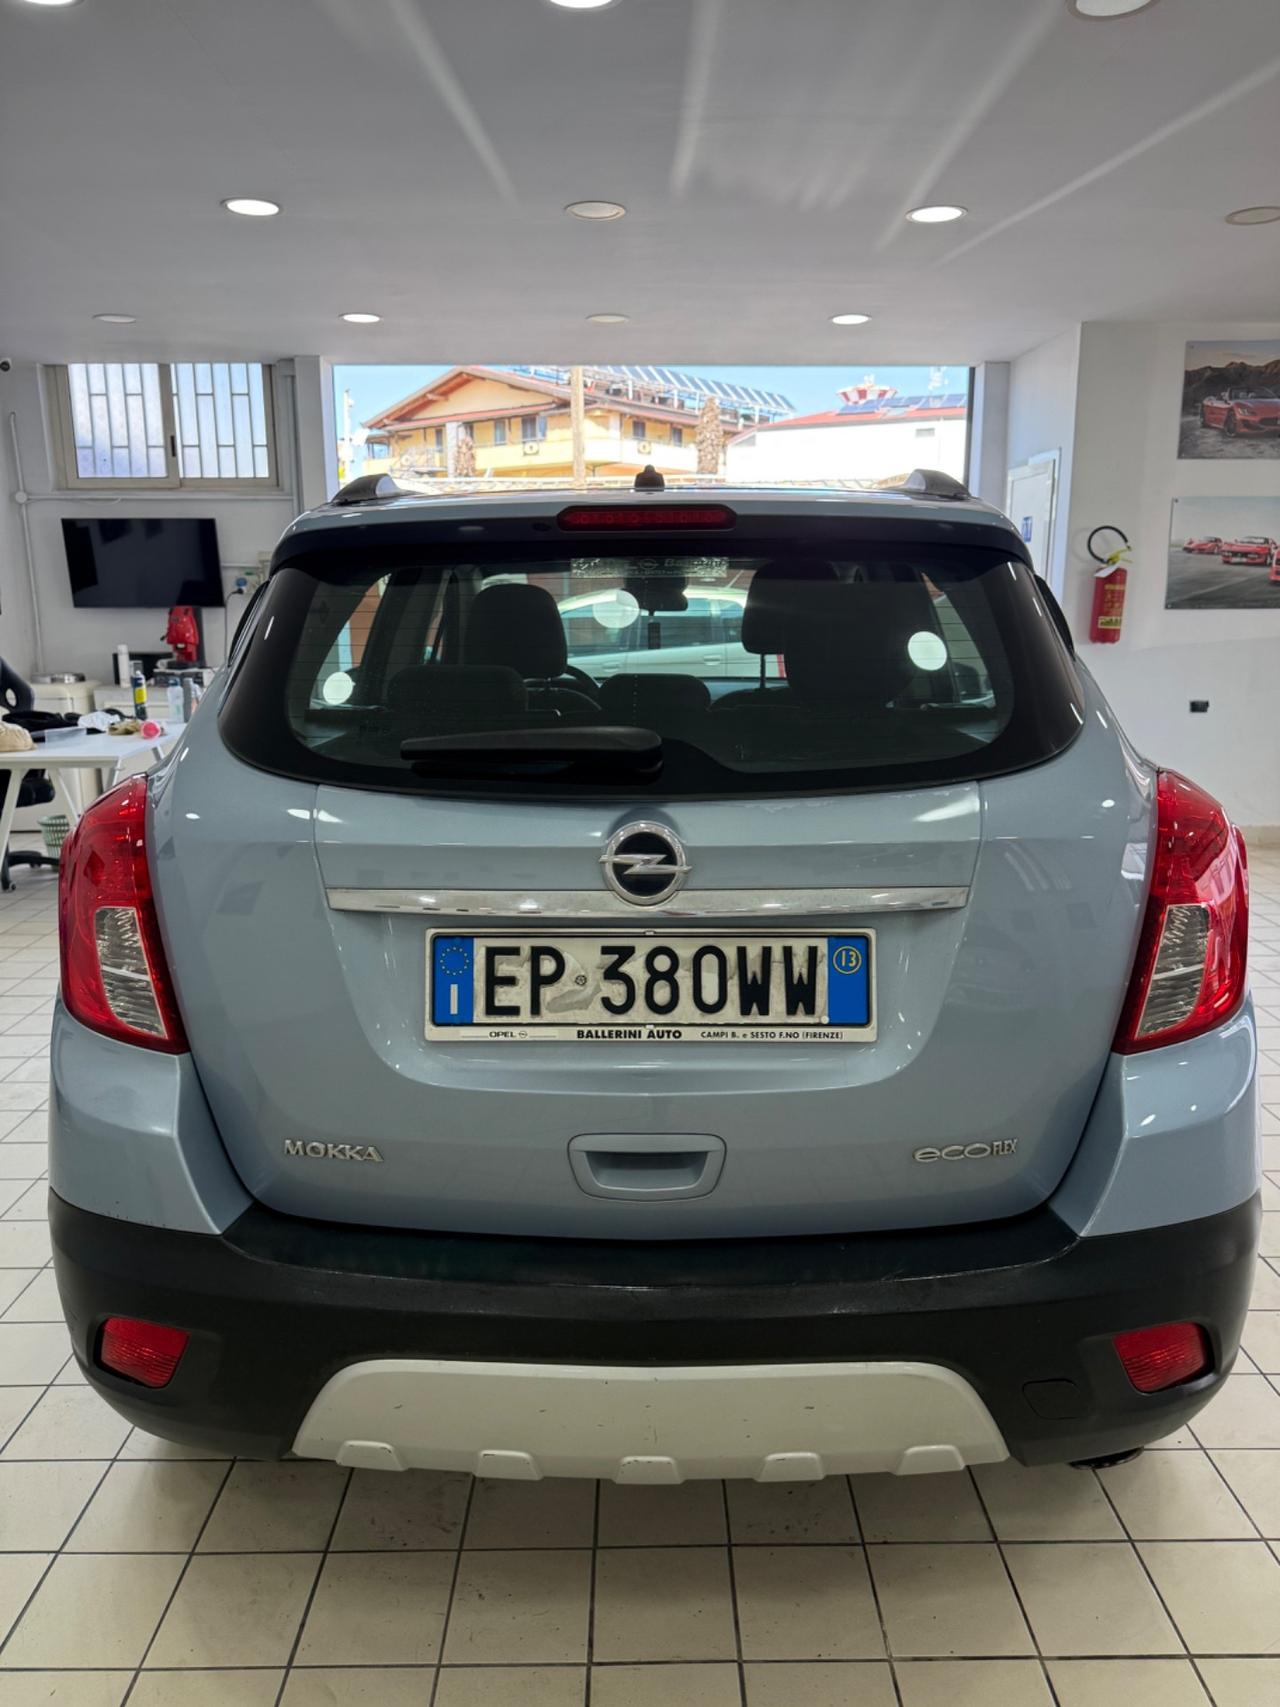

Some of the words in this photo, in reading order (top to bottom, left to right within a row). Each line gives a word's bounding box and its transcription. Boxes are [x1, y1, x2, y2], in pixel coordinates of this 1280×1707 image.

[840, 949, 857, 968] 13
[484, 945, 566, 1017] EP
[449, 983, 459, 1015] I
[489, 1030, 517, 1039] OPEL
[576, 1029, 642, 1040] BALLERINI
[646, 1029, 683, 1040] AUTO
[700, 1030, 729, 1039] CAMPI
[750, 1030, 776, 1039] SESTO
[778, 1030, 800, 1039] F.NO
[801, 1030, 844, 1040] (FIRENZE)
[284, 1138, 384, 1163] MOKKA
